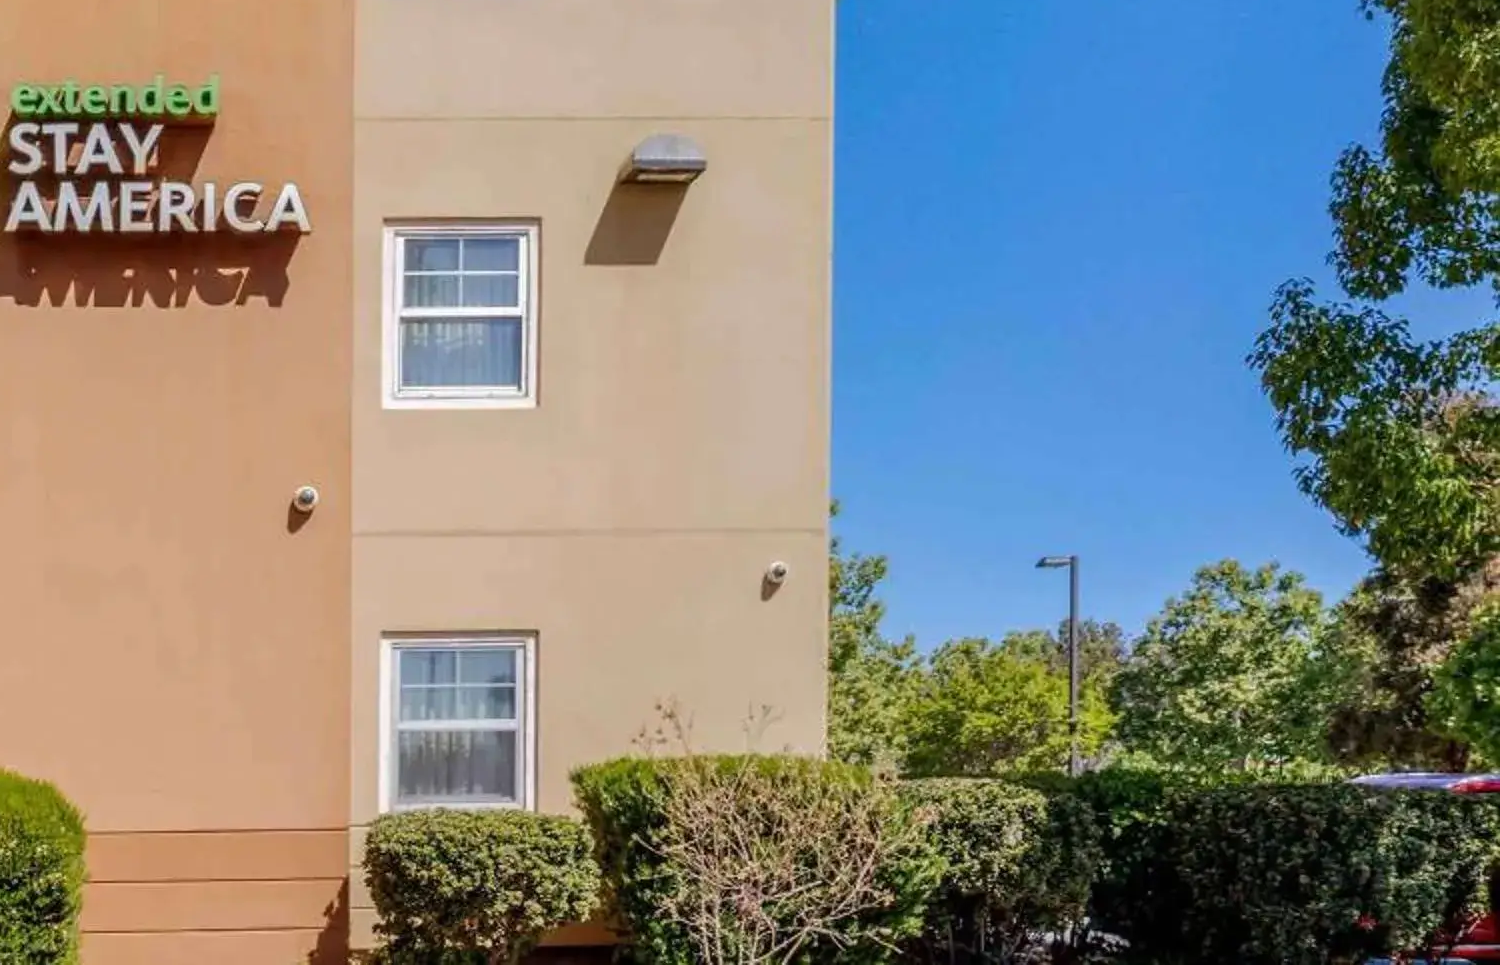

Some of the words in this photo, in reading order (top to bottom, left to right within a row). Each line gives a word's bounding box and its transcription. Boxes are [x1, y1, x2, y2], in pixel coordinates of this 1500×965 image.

[11, 75, 220, 116] extended
[8, 122, 164, 175] STAY
[4, 181, 311, 233] AMERICA
